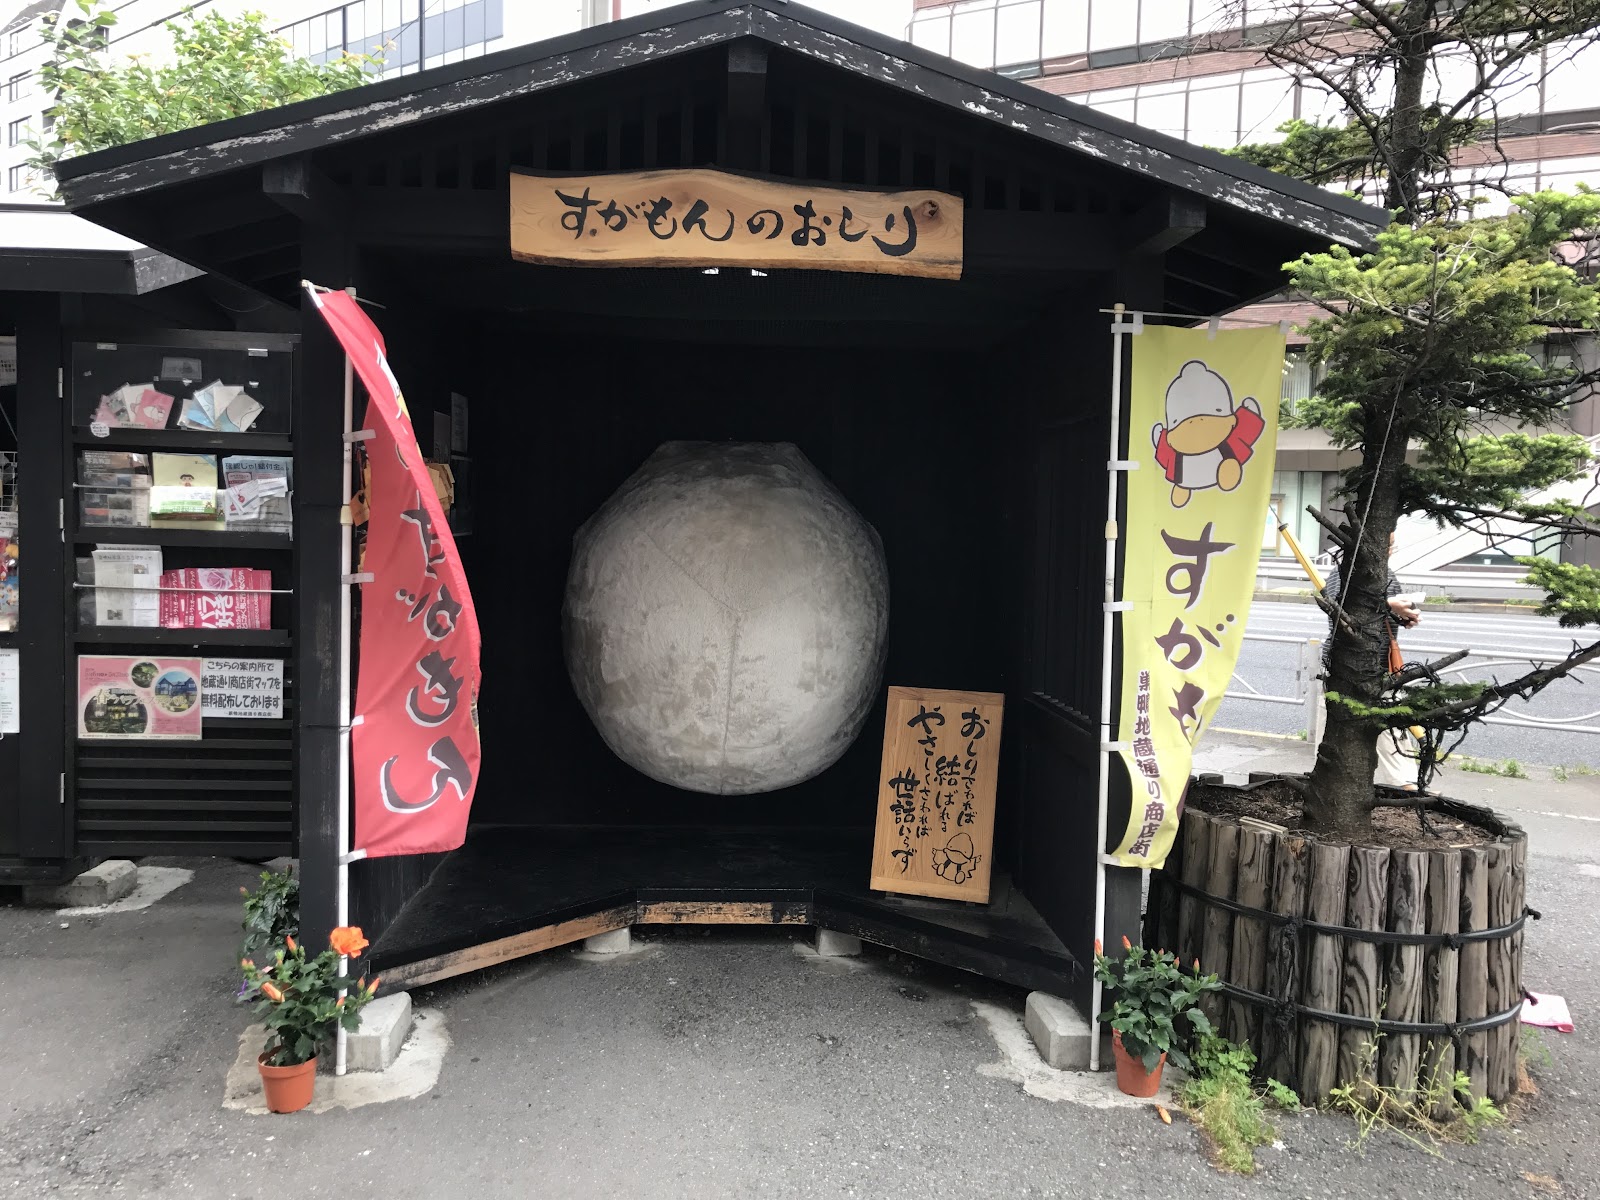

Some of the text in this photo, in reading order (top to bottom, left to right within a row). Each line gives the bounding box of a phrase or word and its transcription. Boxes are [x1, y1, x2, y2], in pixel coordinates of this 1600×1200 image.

[554, 187, 918, 256] すがもんのおしり
[201, 674, 282, 690] 地蔵通り商店街マップを
[201, 692, 281, 709] 無料配布しております
[207, 661, 275, 672] こちらの案内所で
[907, 704, 945, 838] やさしくさわれば
[934, 754, 960, 833] 結ばれる
[956, 706, 990, 827] おしりさわれば
[1128, 670, 1165, 858] 巣鴨地蔵通り商店街
[888, 766, 921, 875] 世話いらず
